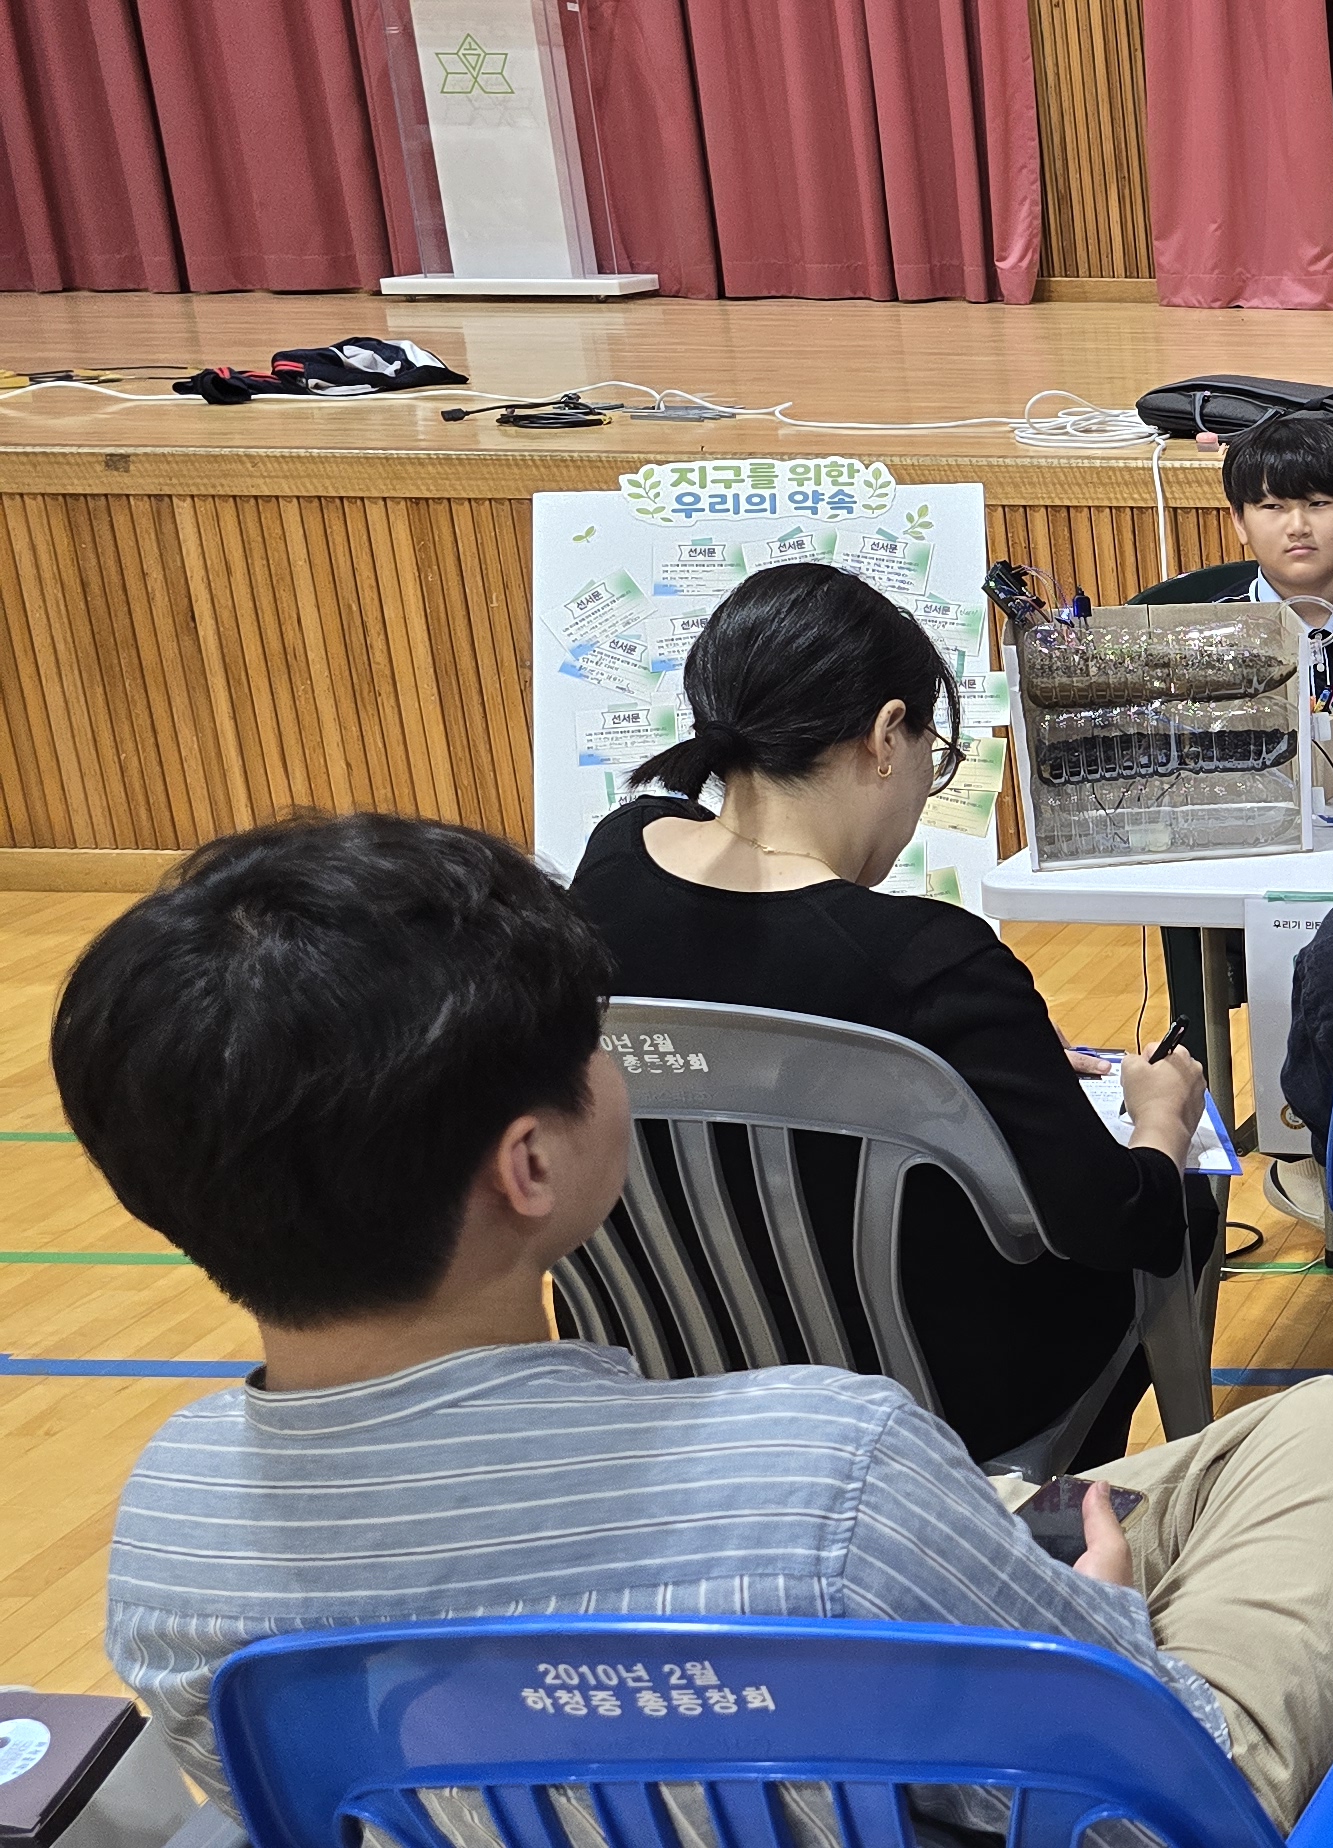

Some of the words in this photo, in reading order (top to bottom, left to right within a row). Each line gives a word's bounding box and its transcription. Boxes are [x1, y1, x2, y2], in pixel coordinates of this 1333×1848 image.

[670, 463, 779, 489] 지구를
[788, 461, 860, 487] 위한
[671, 491, 777, 518] 우리의
[788, 489, 857, 515] 약속
[688, 547, 717, 558] 선서문
[777, 540, 806, 553] 선서문
[870, 541, 898, 554] 선서문
[576, 590, 604, 610] 선서문
[923, 603, 951, 615] 선서문
[609, 638, 637, 655] 선서문
[611, 713, 641, 725] 선서문
[640, 1033, 675, 1052] 2월
[538, 1663, 653, 1687] 2010년
[663, 1660, 720, 1686] 2월
[521, 1688, 622, 1716] 하청중
[636, 1685, 776, 1717] 총동창회
